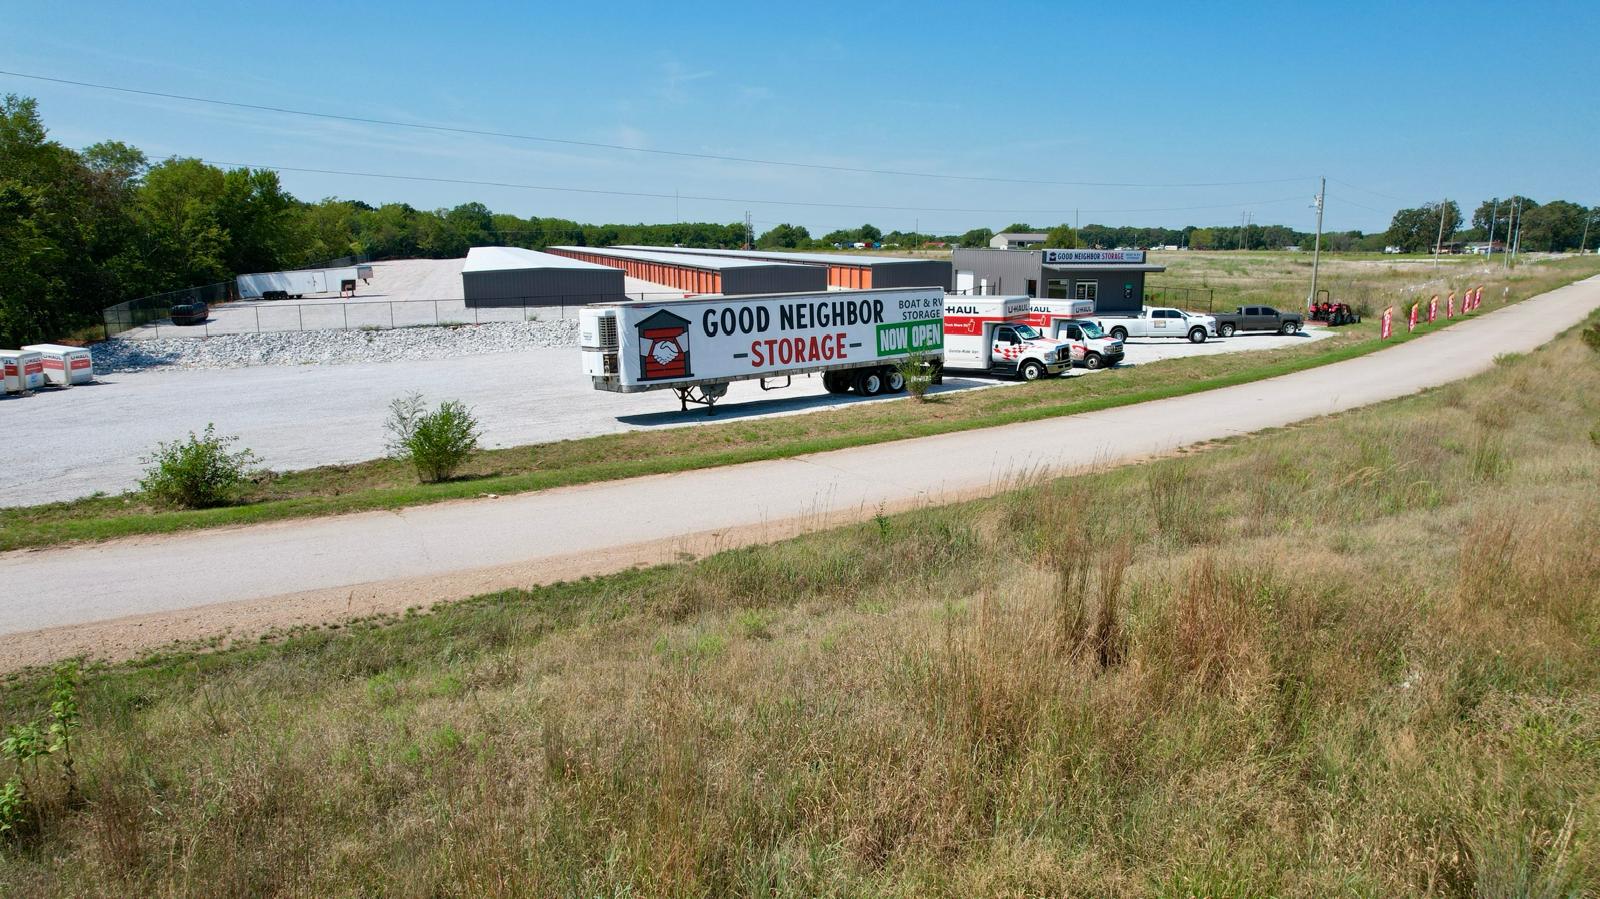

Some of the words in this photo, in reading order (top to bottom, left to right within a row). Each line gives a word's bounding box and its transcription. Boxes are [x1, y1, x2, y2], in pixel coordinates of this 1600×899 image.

[1057, 252, 1073, 260] GOOD
[1074, 252, 1100, 260] NEIGHBOR
[1101, 252, 1124, 260] STORAGE
[898, 299, 921, 310] BOAT
[923, 298, 932, 309] &
[933, 297, 944, 308] RV
[702, 305, 770, 338] GOOD
[780, 299, 884, 331] NEIGHBOR
[902, 309, 941, 321] STORAGE
[880, 327, 908, 352] NOW
[912, 323, 941, 347] OPEN
[751, 333, 848, 368] STORAGE
